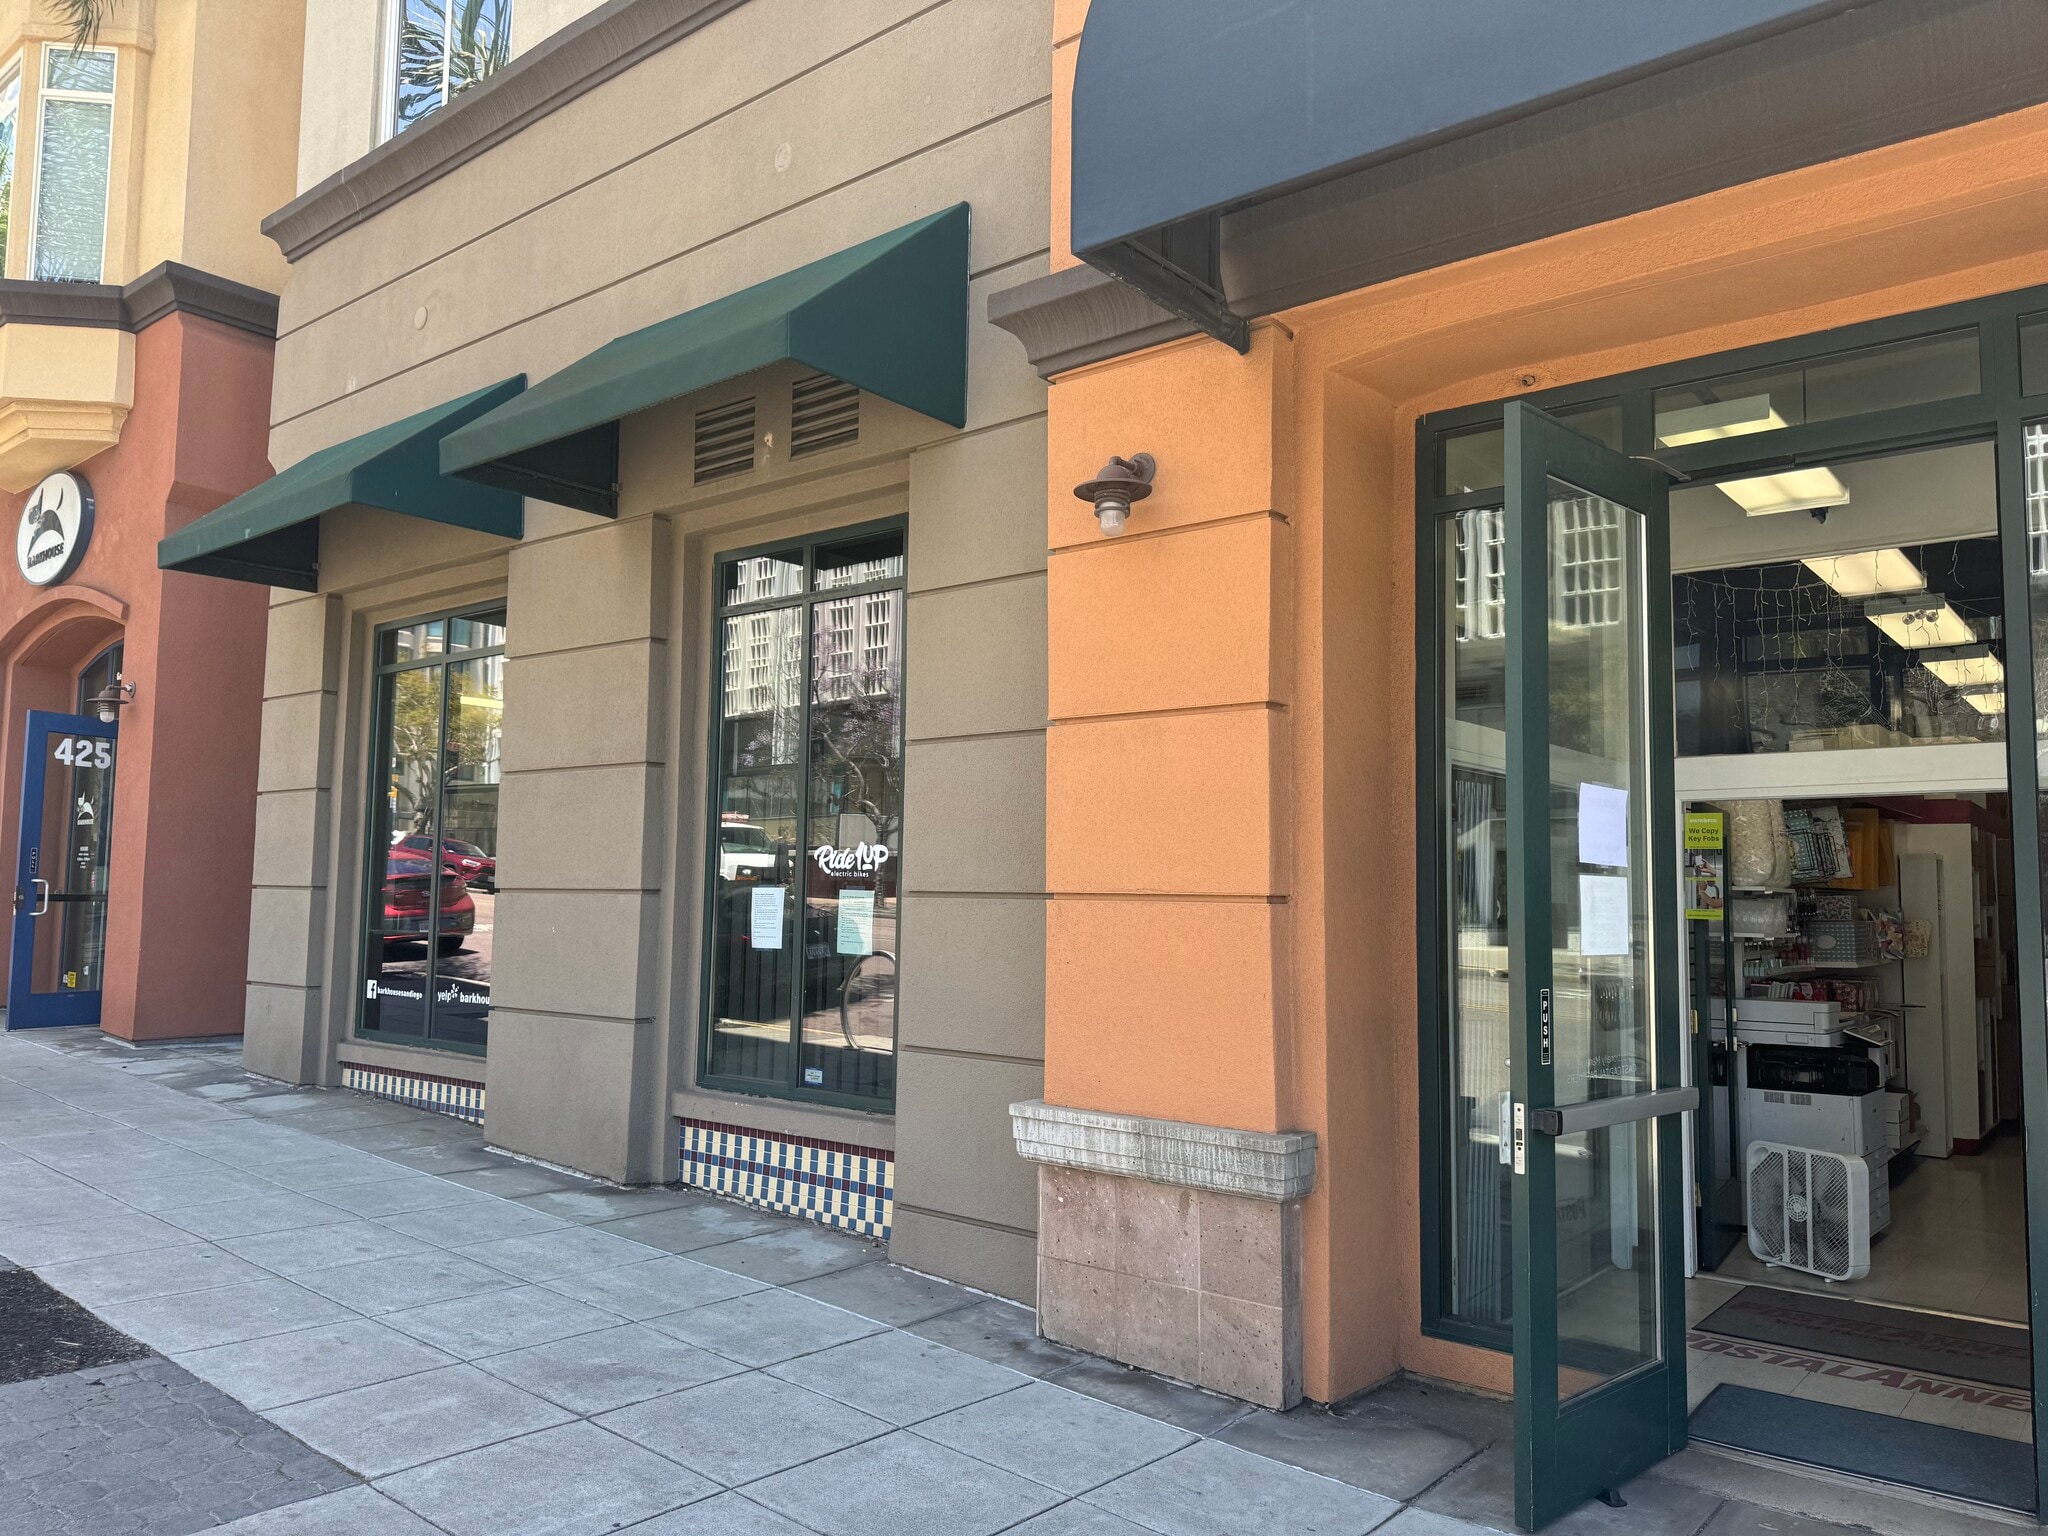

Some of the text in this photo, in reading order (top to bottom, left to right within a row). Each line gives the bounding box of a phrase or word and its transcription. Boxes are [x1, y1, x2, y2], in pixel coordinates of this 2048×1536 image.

[54, 738, 111, 769] 425
[1701, 827, 1719, 836] Copy
[1688, 835, 1701, 843] Key
[853, 870, 869, 878] bikes
[377, 986, 423, 1001] barkhousesandiego
[437, 990, 452, 1003] yelp
